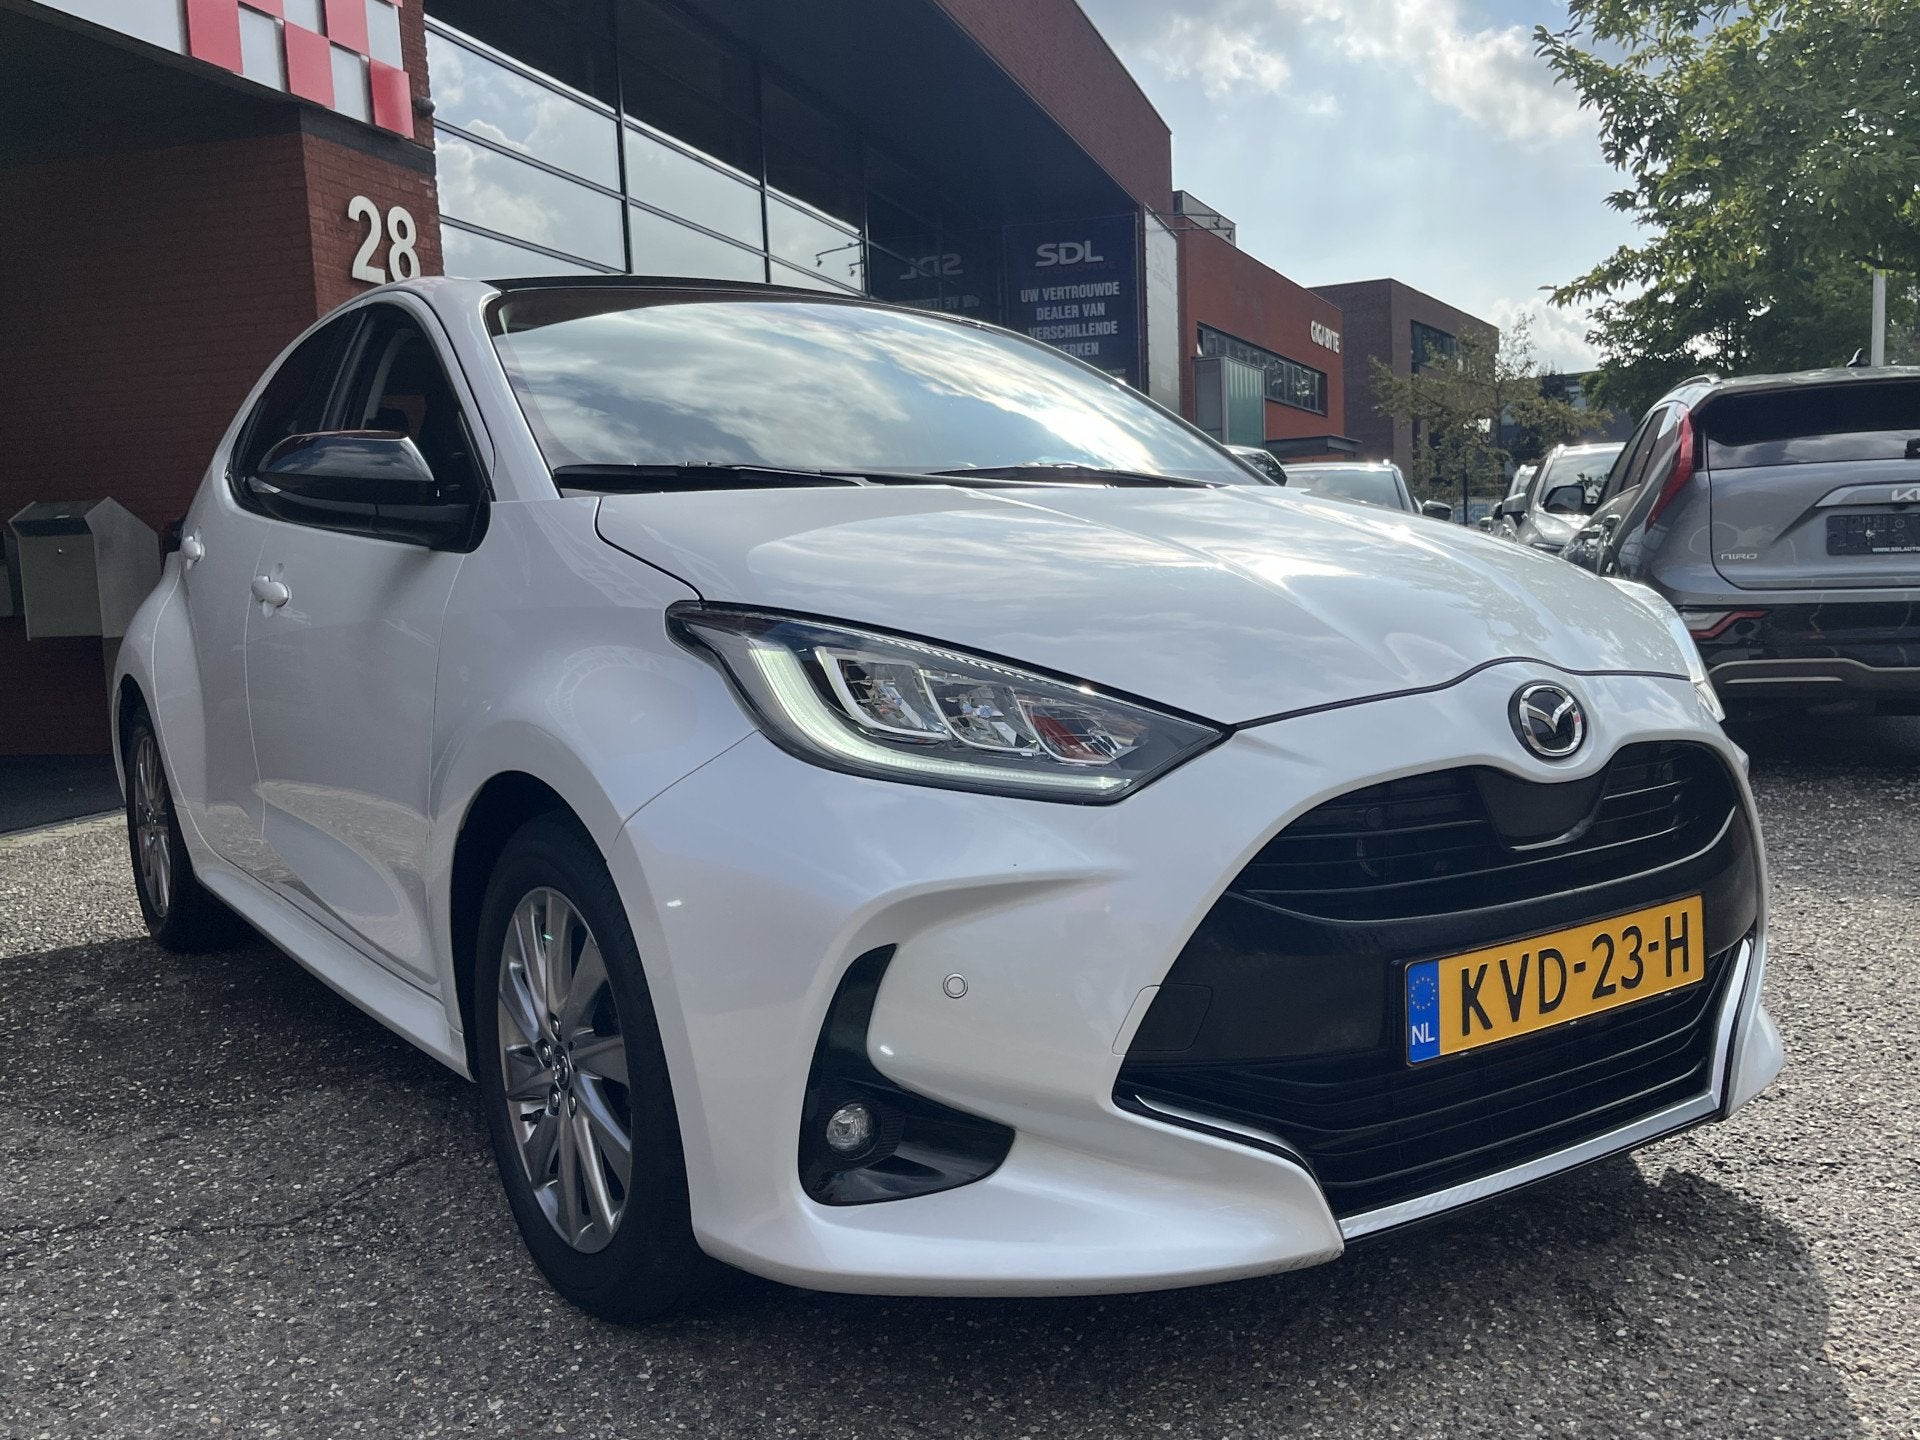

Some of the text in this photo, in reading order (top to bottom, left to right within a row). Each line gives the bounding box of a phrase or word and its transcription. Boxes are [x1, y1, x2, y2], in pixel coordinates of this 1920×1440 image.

[348, 195, 421, 284] 28
[1035, 240, 1104, 267] SDL
[1020, 281, 1120, 303] UW VERTROUWDE
[1036, 302, 1105, 321] DEALER VAN
[1028, 321, 1118, 340] VERSCHILLENDE
[1311, 320, 1340, 354] GIGABYTE
[1057, 342, 1099, 357] ERKEN
[1460, 911, 1690, 1036] KVD-23-H
[1411, 1022, 1436, 1045] NL
